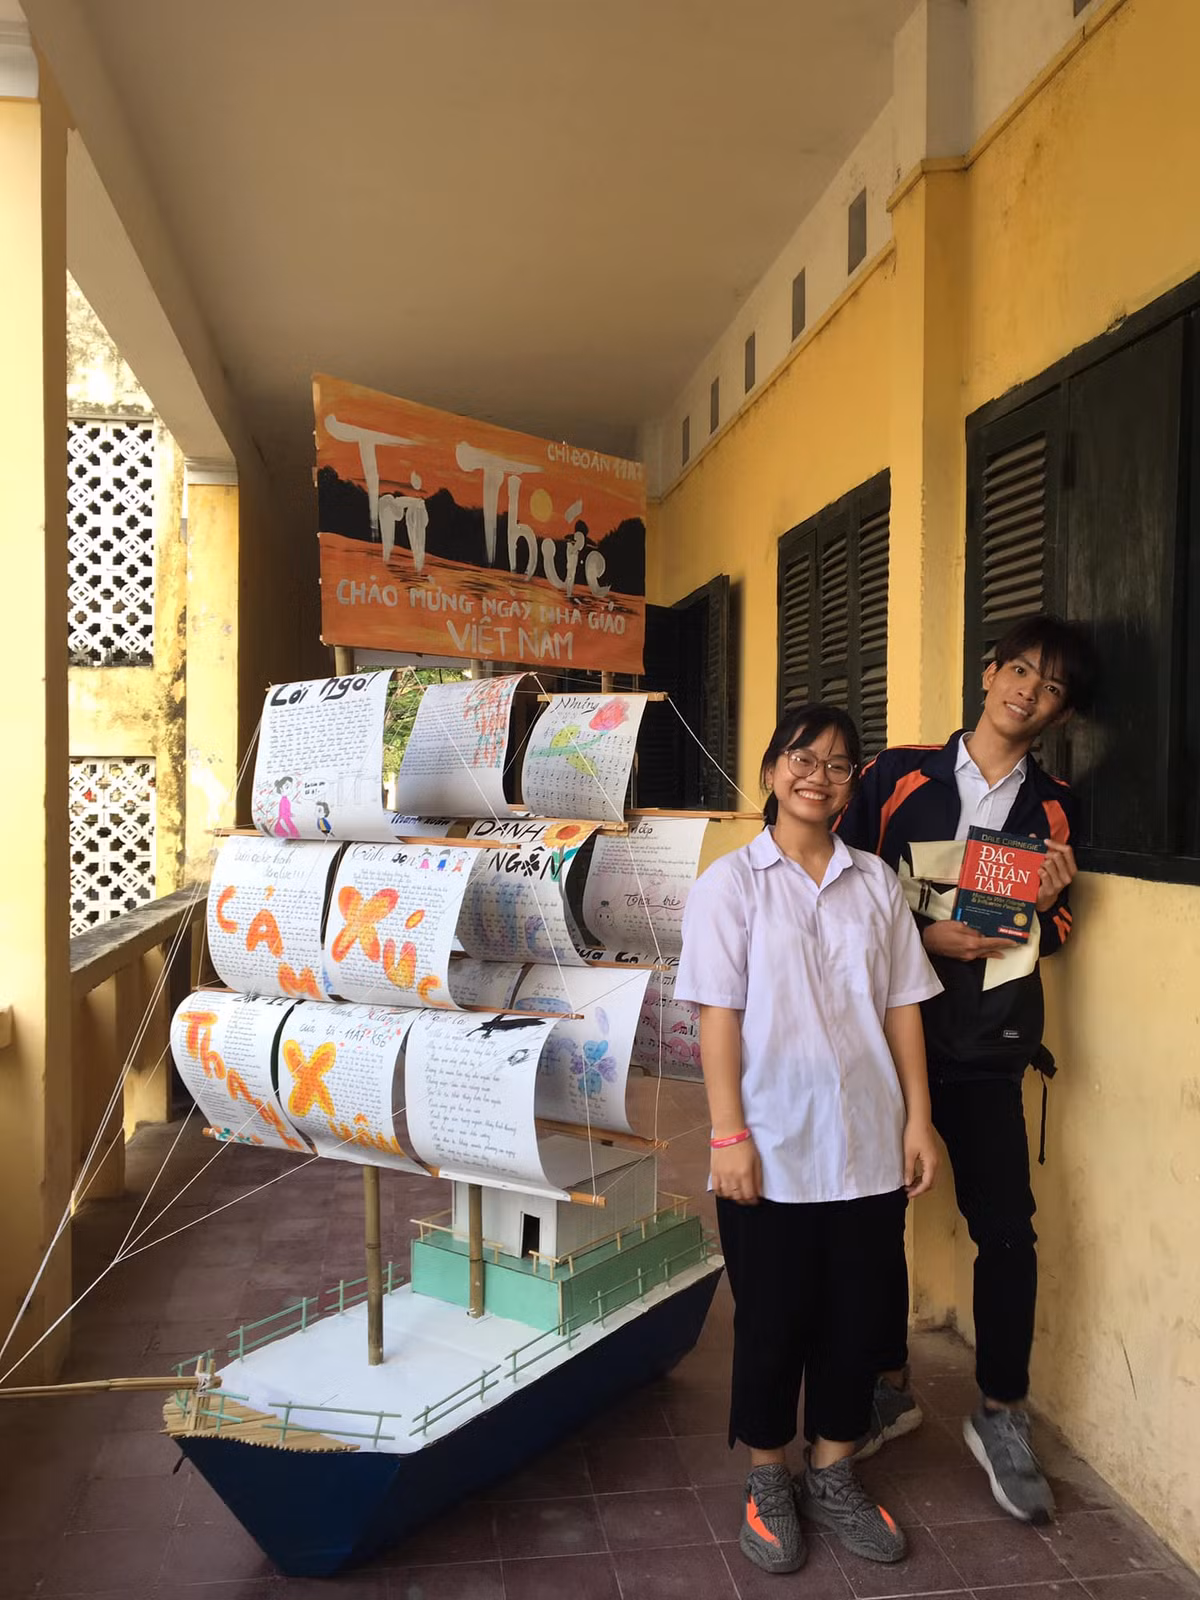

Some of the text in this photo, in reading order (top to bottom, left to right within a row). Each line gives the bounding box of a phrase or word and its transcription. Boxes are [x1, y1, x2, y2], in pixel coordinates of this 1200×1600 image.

[336, 575, 398, 607] CHÀO
[409, 575, 474, 615] MỪNG
[481, 589, 531, 621] NGÀY
[518, 627, 574, 660] NAM
[474, 820, 546, 842] DANH
[976, 860, 1031, 884] NHÂN
[975, 874, 1013, 896] TÂM
